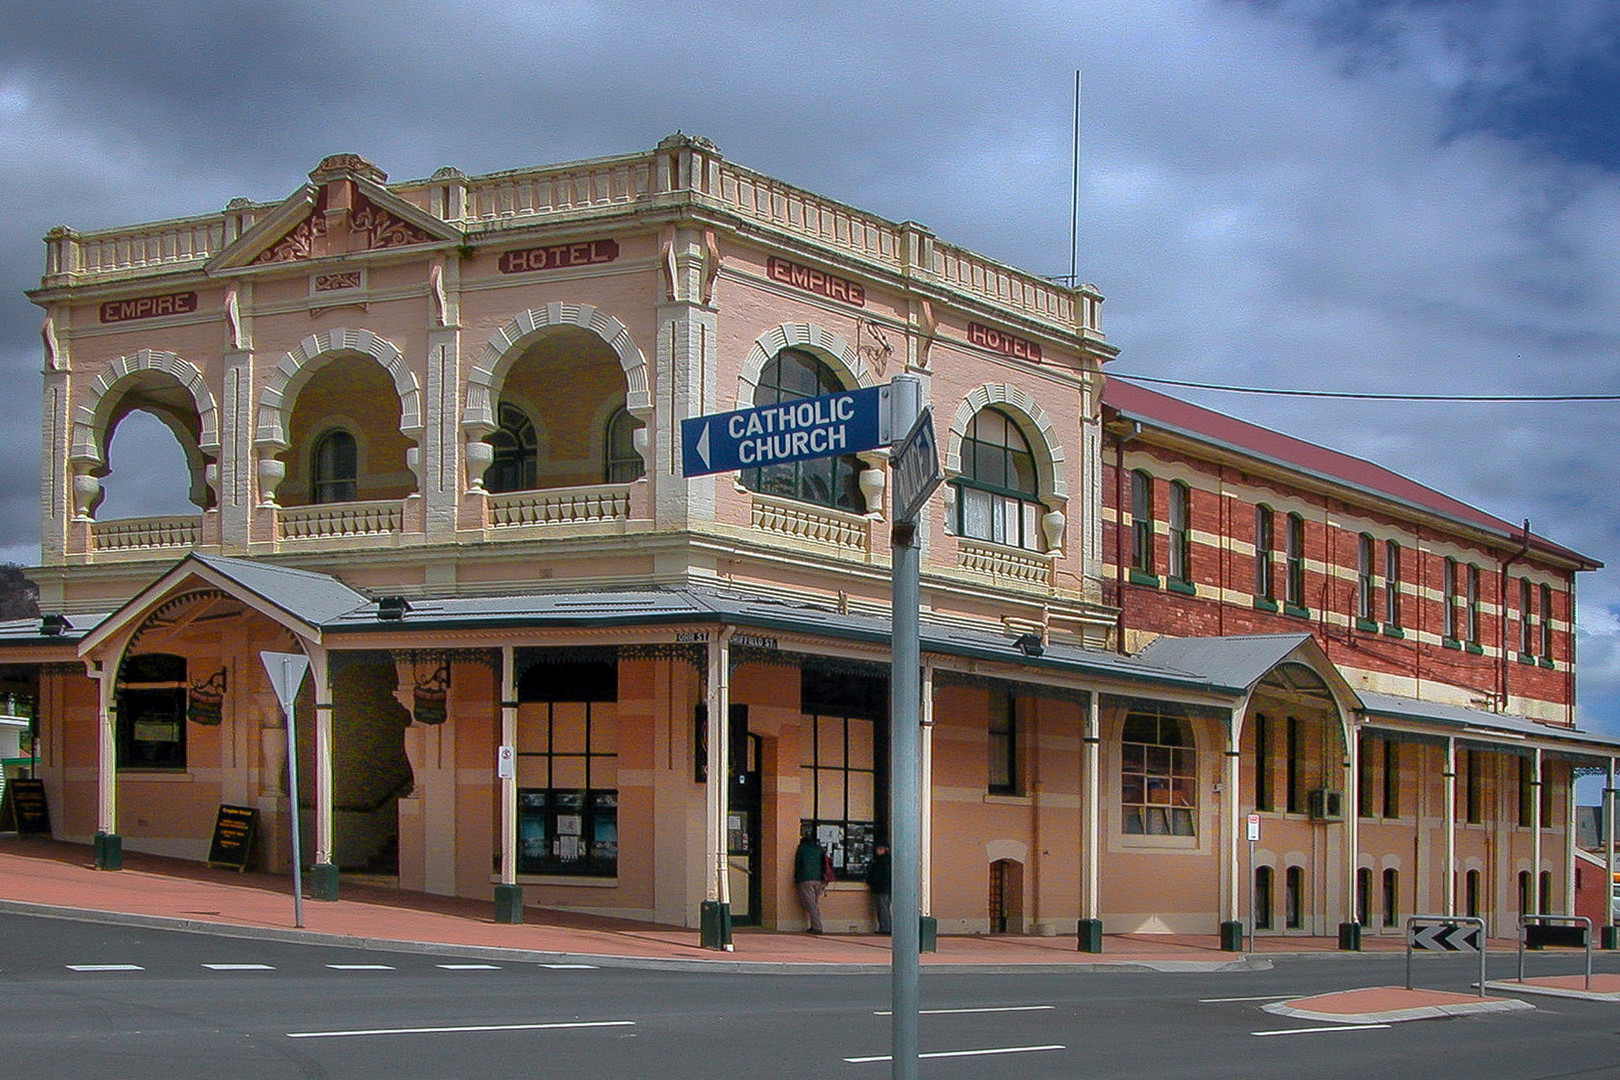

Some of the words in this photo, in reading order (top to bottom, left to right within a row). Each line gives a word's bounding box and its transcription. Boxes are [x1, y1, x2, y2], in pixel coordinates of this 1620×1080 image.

[508, 242, 610, 272] HOTEL
[774, 259, 864, 305] EMPIRE
[106, 293, 190, 321] EMPIRE
[973, 324, 1040, 361] HOTEL
[728, 396, 855, 439] CATHOLIC
[738, 425, 846, 464] CHURCH
[697, 632, 708, 641] ST
